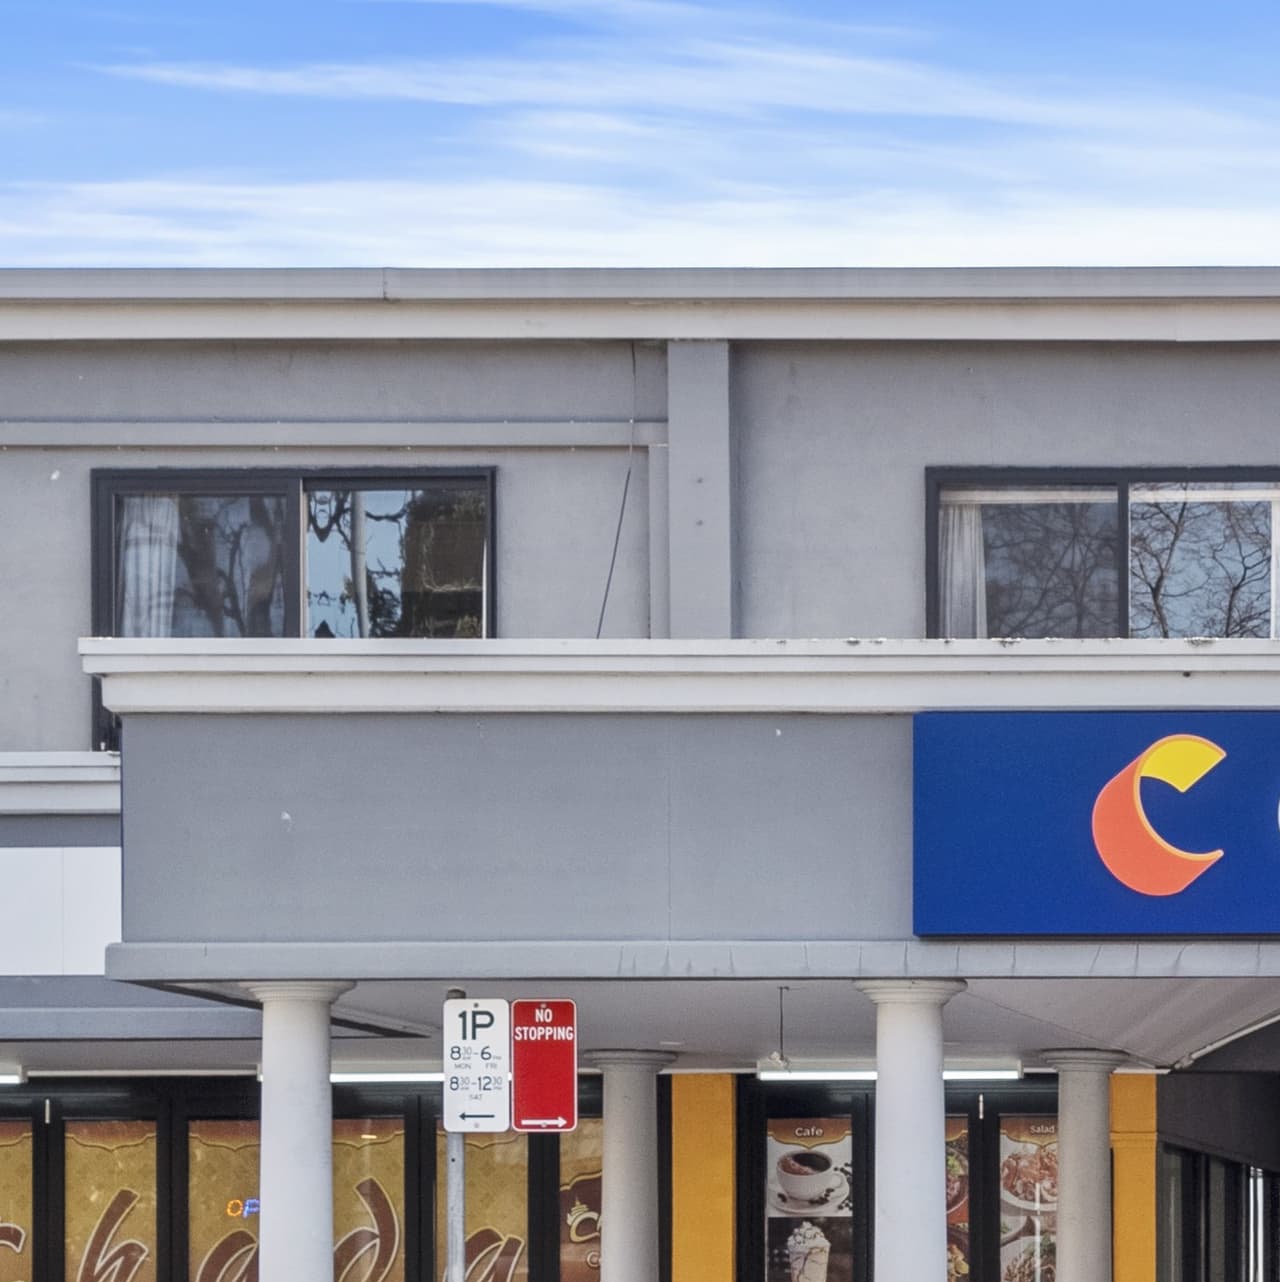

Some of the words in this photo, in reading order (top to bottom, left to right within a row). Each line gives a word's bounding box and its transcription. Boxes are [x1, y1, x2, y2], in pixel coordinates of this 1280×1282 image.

[535, 1008, 553, 1023] NO
[458, 1010, 495, 1040] 1P
[514, 1026, 574, 1041] STOPPING
[795, 1126, 823, 1138] Cafe
[1029, 1124, 1056, 1135] Salad
[227, 1199, 260, 1218] OP
